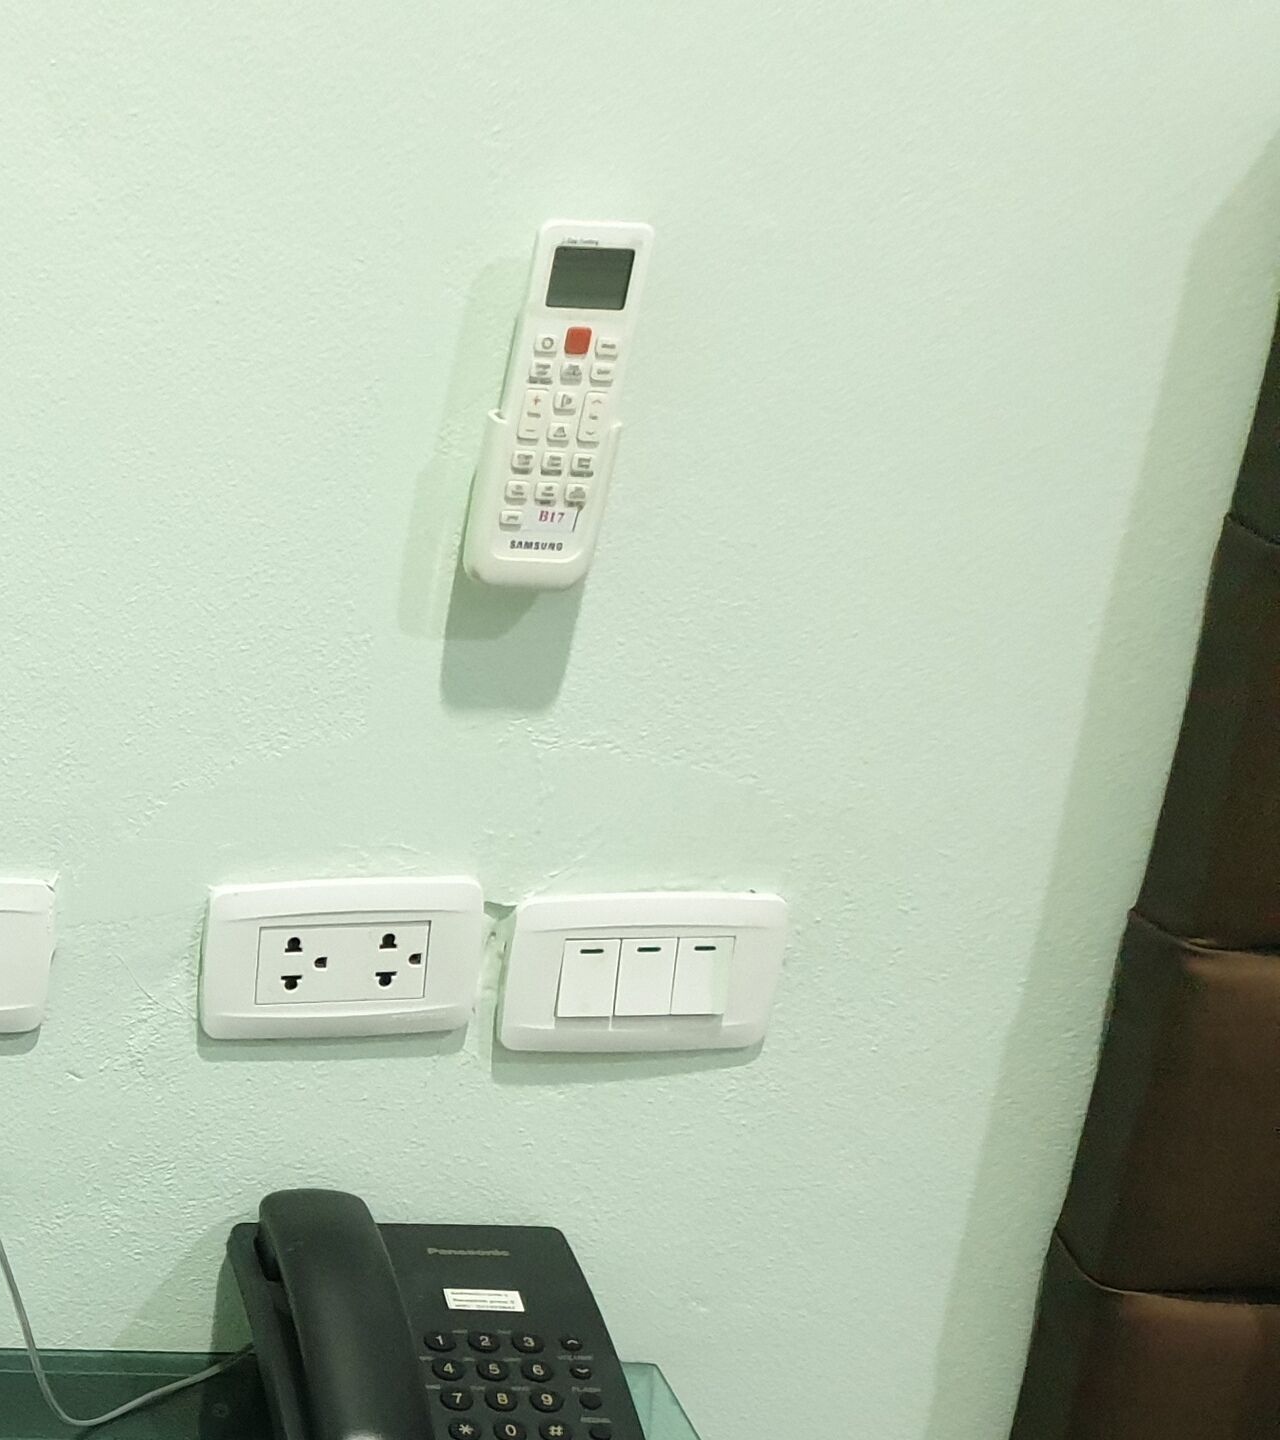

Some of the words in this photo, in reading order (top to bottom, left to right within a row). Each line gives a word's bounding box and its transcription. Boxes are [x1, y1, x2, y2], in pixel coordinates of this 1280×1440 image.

[538, 510, 565, 523] B17
[509, 539, 564, 552] SAMSUNG
[479, 1335, 491, 1347] 2
[523, 1336, 535, 1348] 3
[443, 1362, 455, 1374] 4
[488, 1363, 500, 1375] 5
[532, 1364, 544, 1376] 6
[452, 1392, 463, 1404] 7
[497, 1393, 509, 1405] 8
[541, 1393, 553, 1406] 9
[505, 1424, 517, 1437] 0
